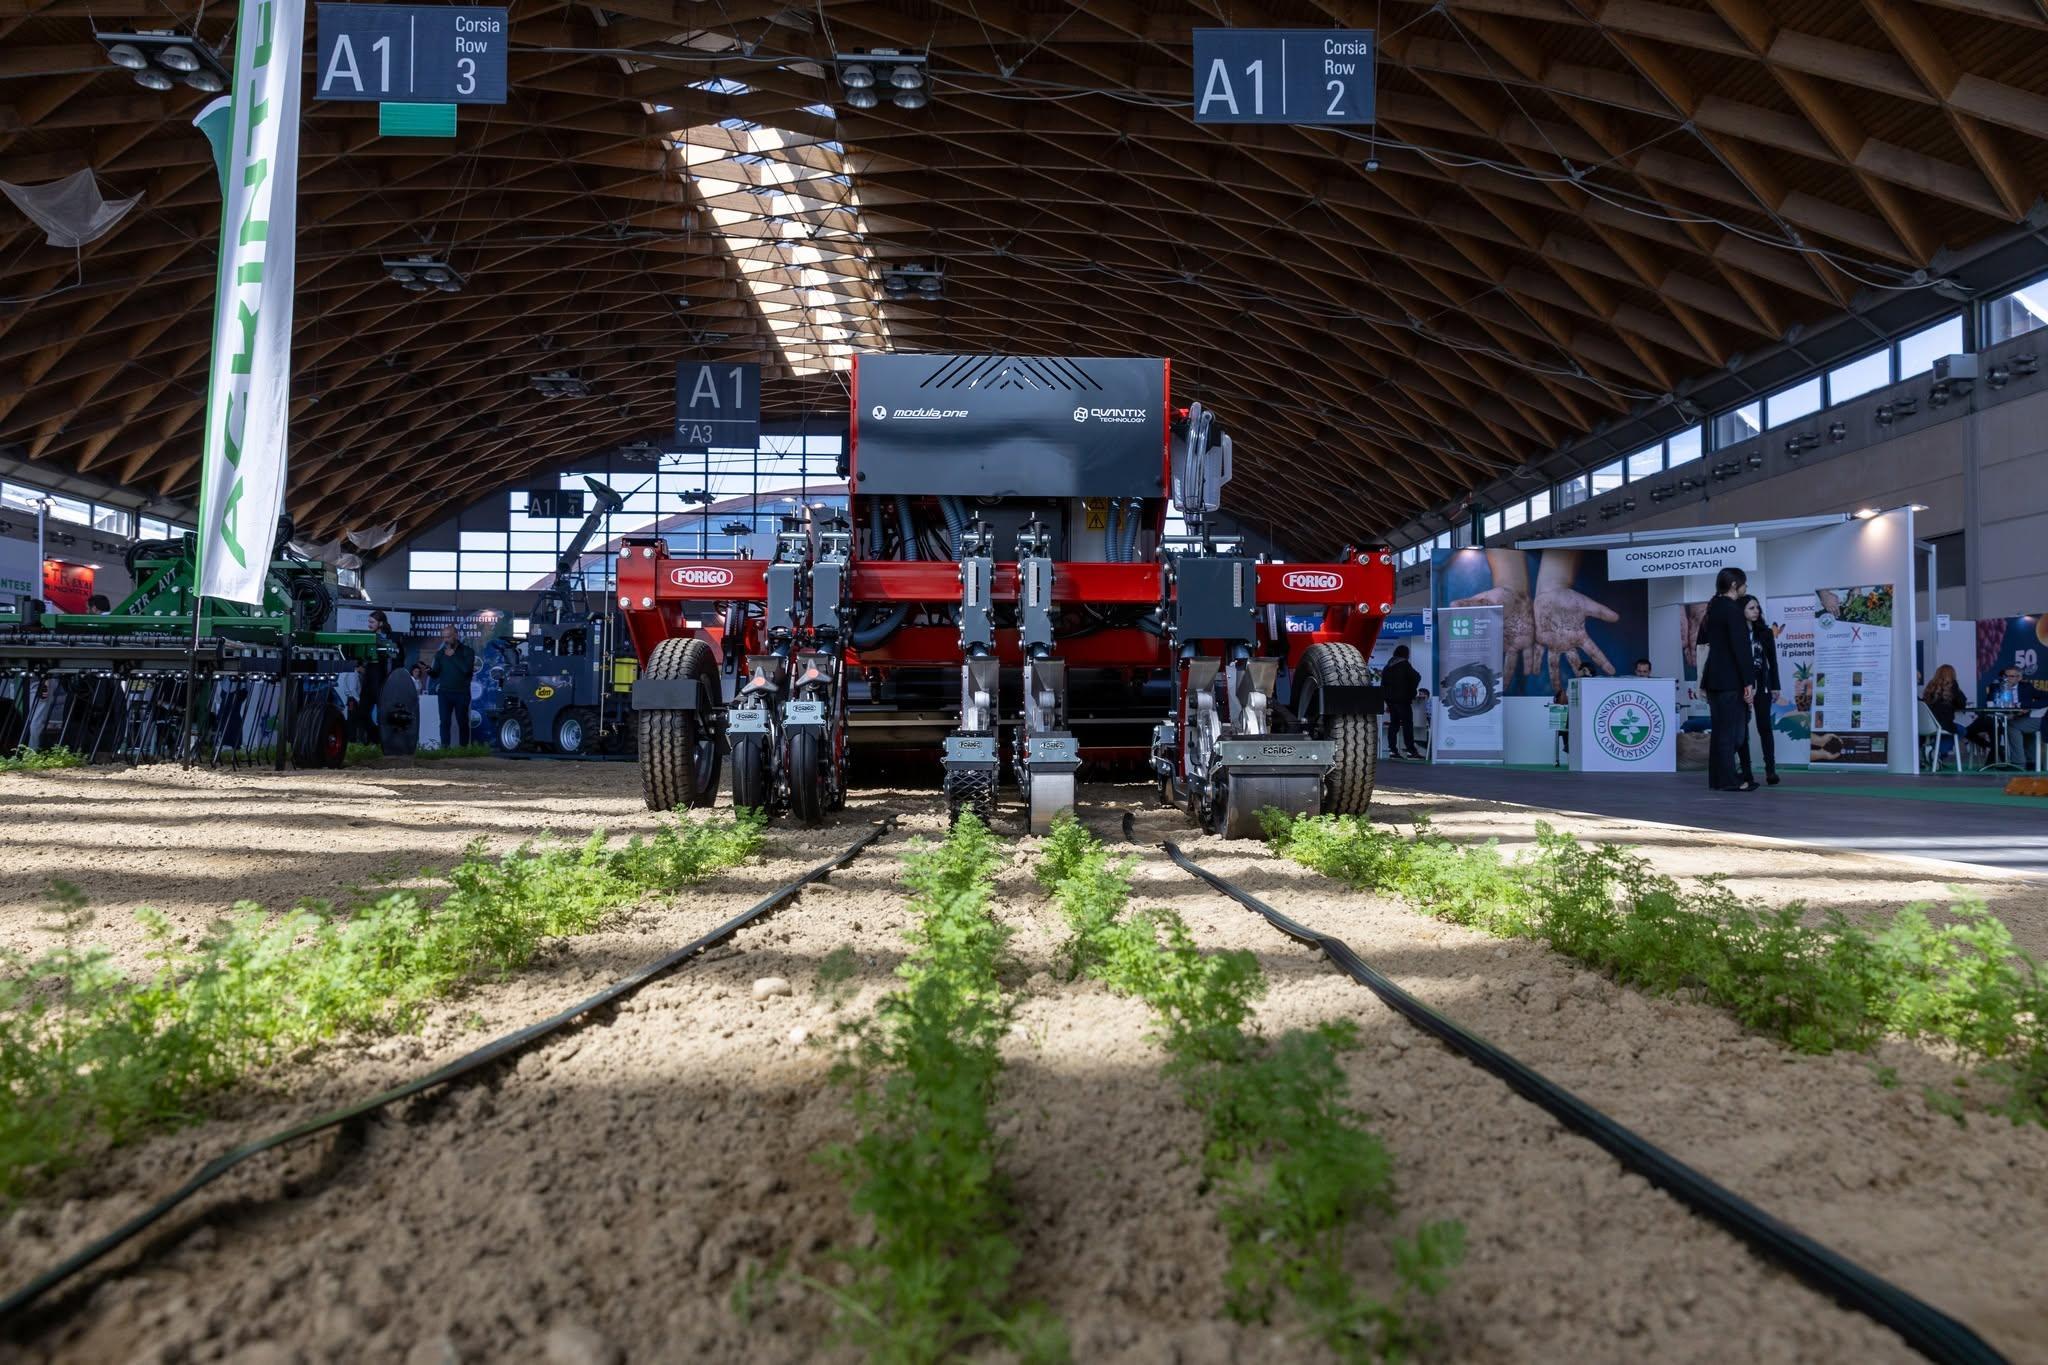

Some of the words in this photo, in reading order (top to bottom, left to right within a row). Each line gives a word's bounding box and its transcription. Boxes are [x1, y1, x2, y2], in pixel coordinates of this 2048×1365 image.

[455, 16, 500, 33] Corsia
[455, 37, 487, 53] Row
[1324, 38, 1367, 55] Corsia
[321, 34, 390, 92] A1
[1325, 59, 1355, 75] Row
[456, 58, 476, 95] 3
[1199, 58, 1264, 115] A1
[1326, 80, 1345, 116] 2
[689, 365, 742, 408] A1
[689, 424, 713, 443] A3
[530, 497, 551, 516] A1
[568, 504, 576, 515] 4
[1625, 549, 1685, 561] CONSORZIO
[1687, 545, 1736, 556] ITALIANO
[1641, 559, 1722, 573] COMPOSTATORI
[677, 570, 727, 584] FORIGO
[1289, 574, 1337, 588] FORIGO
[2015, 649, 2037, 668] 50
[1598, 693, 1632, 734] CONSORZIO
[1636, 695, 1662, 734] ITALIANO
[1263, 746, 1294, 754] FORIGO
[1601, 735, 1659, 758] COMPOSTATORI
